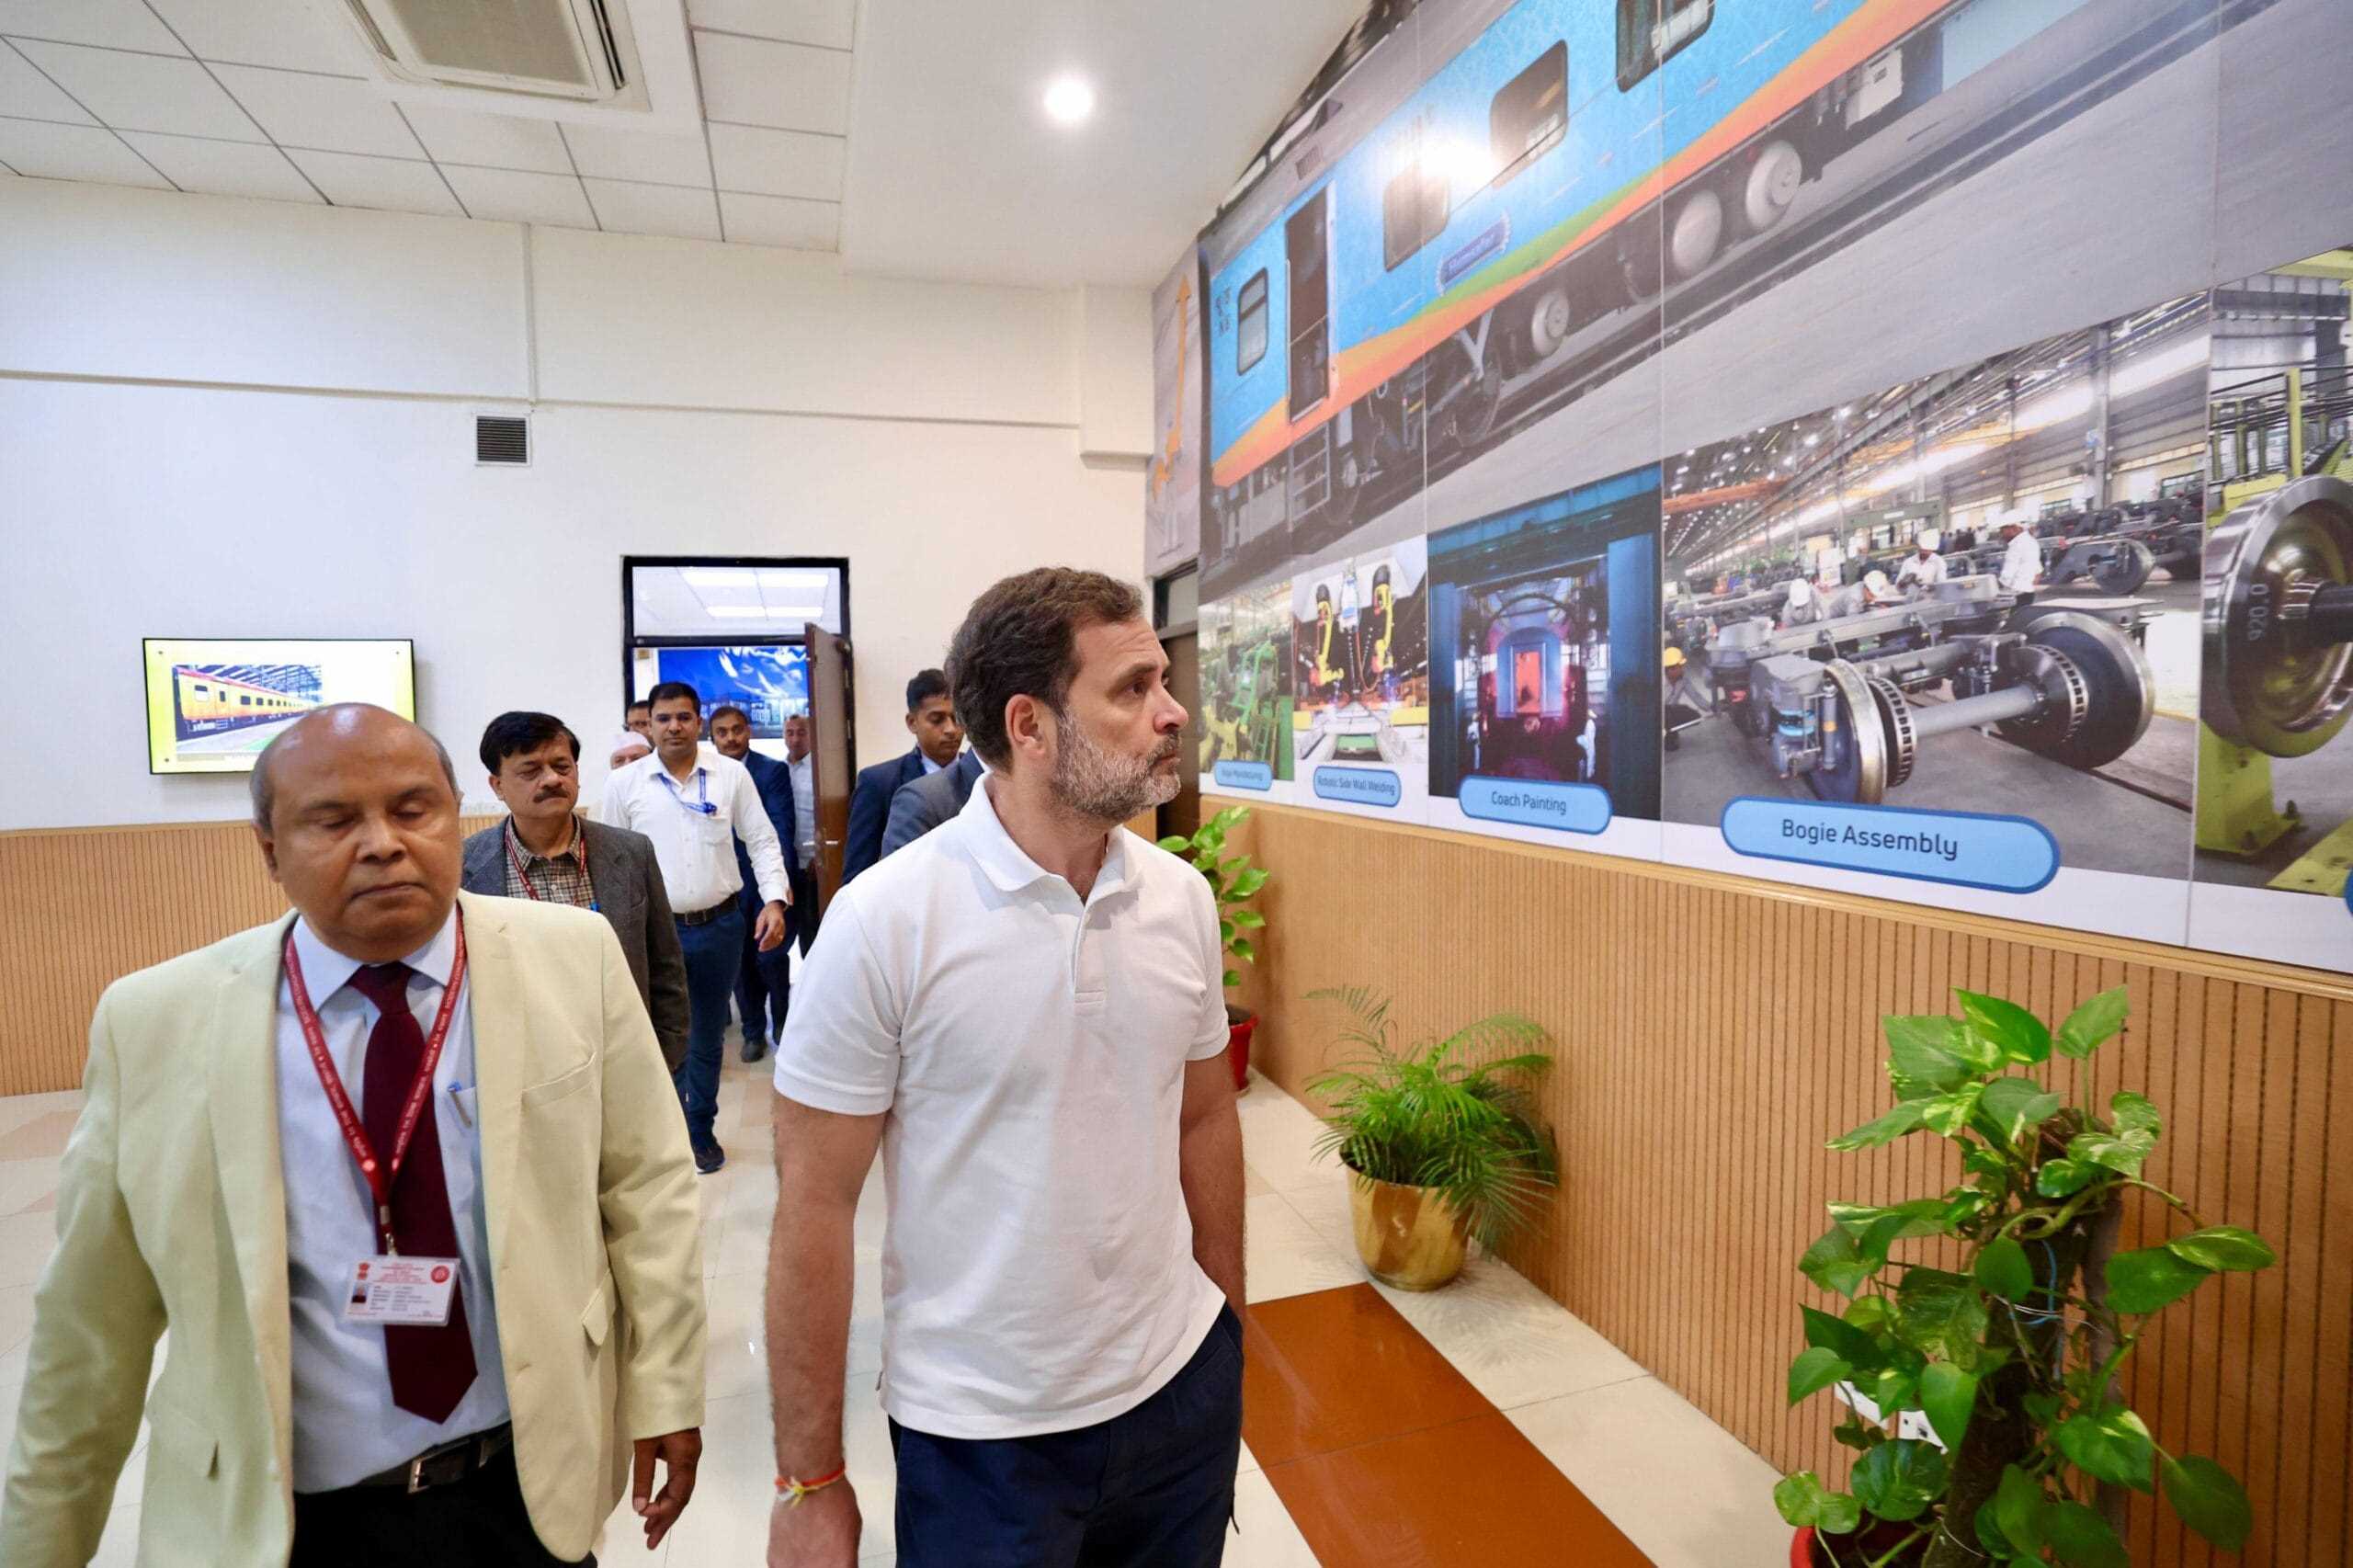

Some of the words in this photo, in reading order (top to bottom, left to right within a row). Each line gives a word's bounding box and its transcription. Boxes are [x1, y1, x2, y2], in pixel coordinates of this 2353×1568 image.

[2248, 584, 2269, 641] 920.0
[1353, 778, 1366, 790] Wall
[1368, 780, 1395, 796] Welding
[1491, 790, 1520, 807] Coach
[1522, 794, 1567, 815] Painting
[1782, 819, 1836, 845] Bogie
[1842, 825, 1958, 861] Assembly
